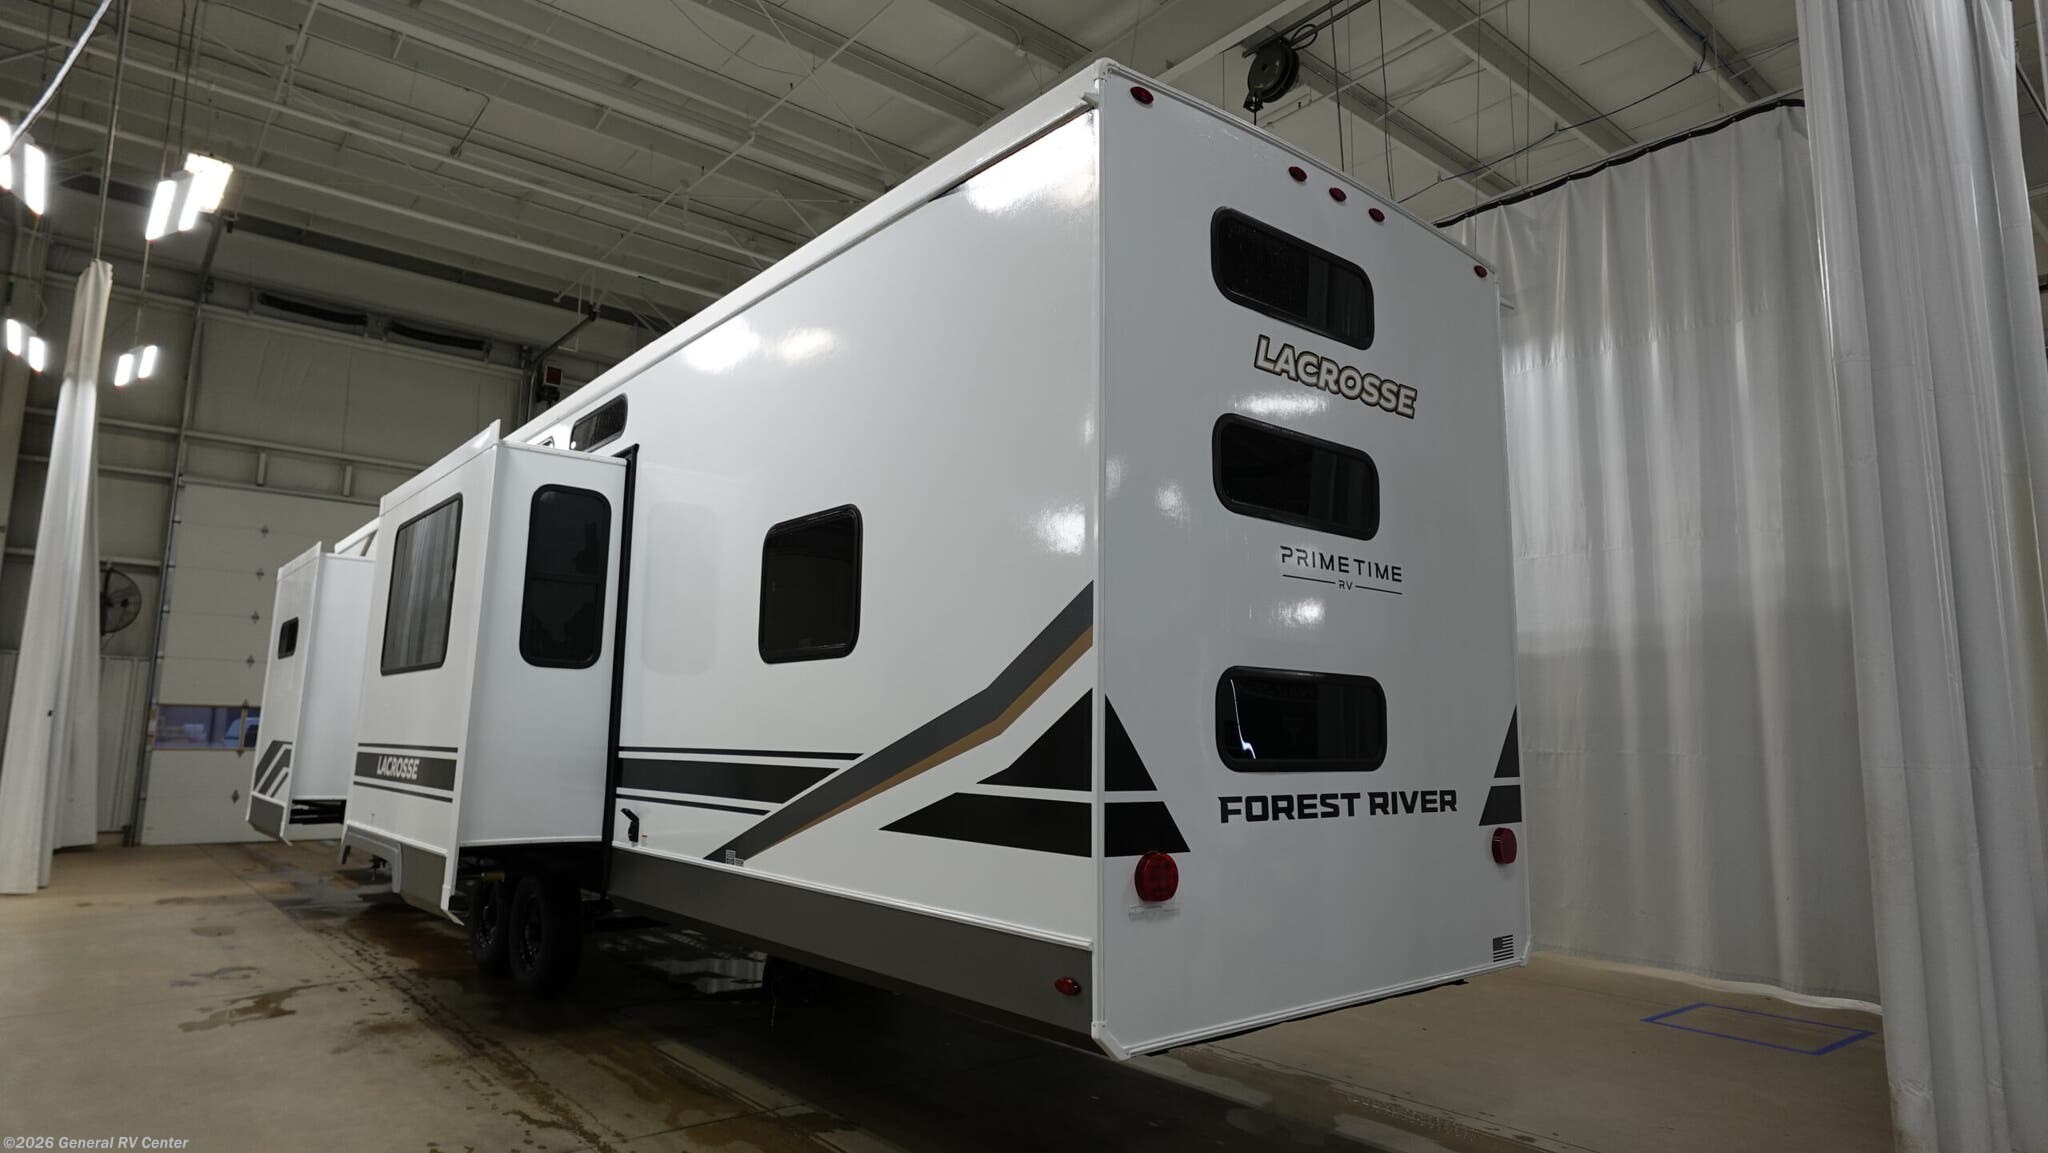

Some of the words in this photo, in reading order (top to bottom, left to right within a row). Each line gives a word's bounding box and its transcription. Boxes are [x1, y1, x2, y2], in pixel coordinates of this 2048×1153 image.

[1254, 334, 1417, 419] LACROSSE
[1338, 580, 1353, 590] RV
[376, 755, 420, 779] LACROSSE
[1218, 793, 1361, 824] FOREST
[1368, 789, 1458, 817] RIVER
